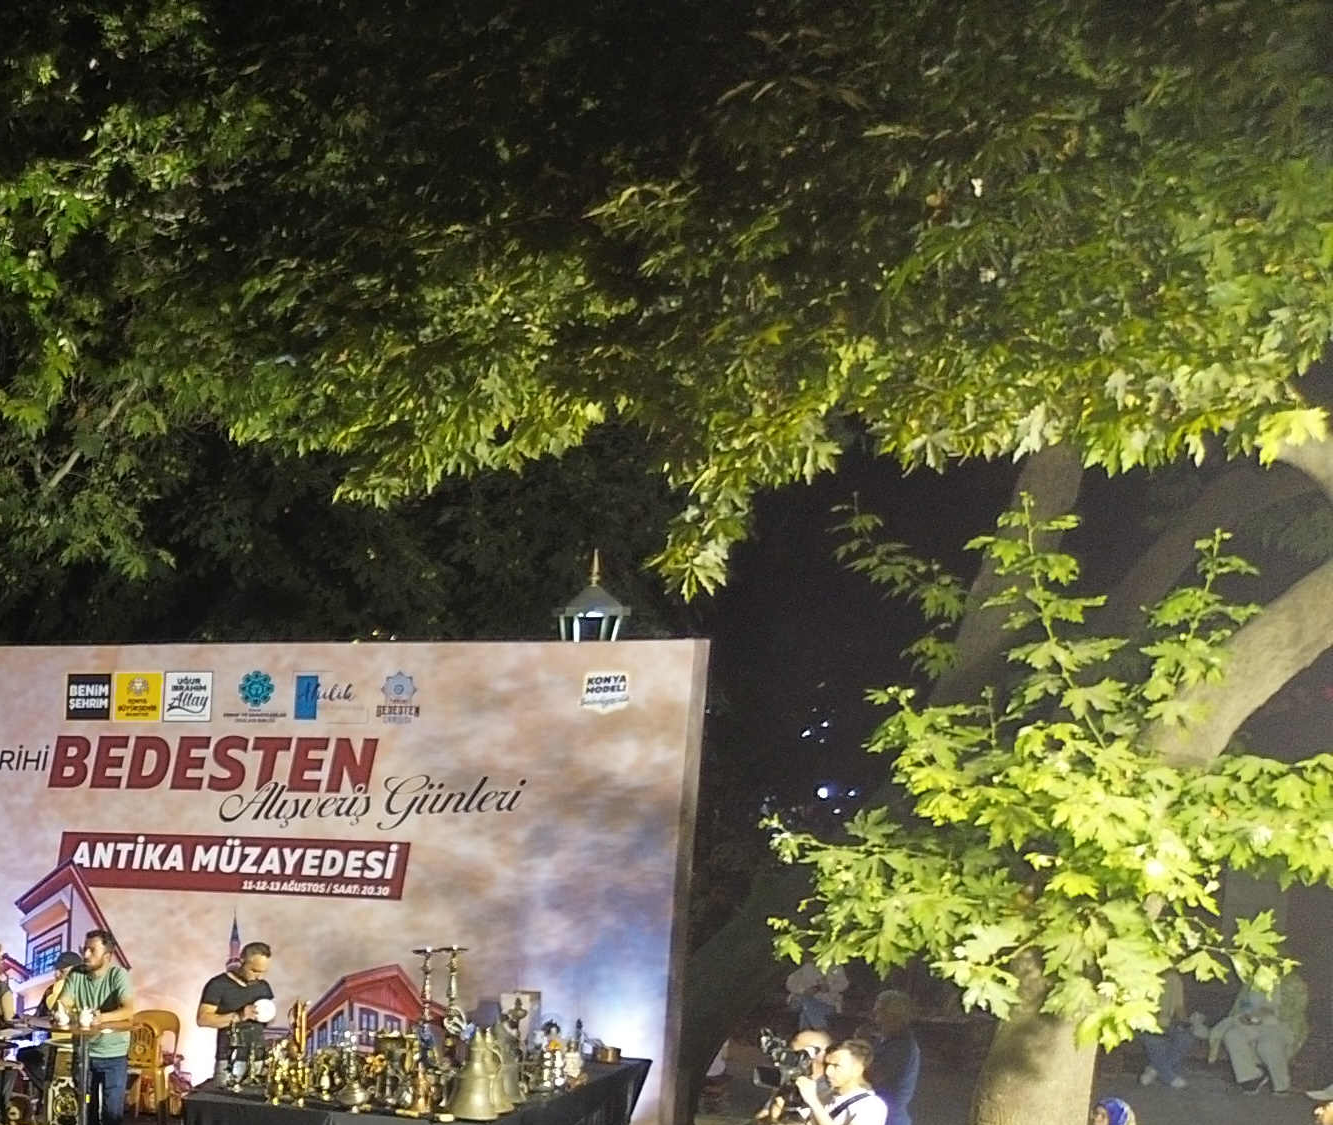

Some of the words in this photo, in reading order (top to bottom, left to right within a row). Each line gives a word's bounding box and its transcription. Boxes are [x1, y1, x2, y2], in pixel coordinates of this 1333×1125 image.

[176, 676, 201, 685] UĞUR
[587, 674, 627, 685] KONYA
[166, 690, 209, 714] Altay
[48, 735, 378, 794] BEDESTEN
[218, 780, 372, 829] Alışveriş
[376, 774, 527, 831] Günleri
[71, 835, 185, 871] ANTİKA
[190, 839, 399, 881] MÜZAYEDESİ
[242, 880, 281, 891] 11-12-13
[281, 879, 325, 893] AĞUSTOS
[332, 883, 360, 895] SAAT:
[360, 885, 391, 896] 20.30
